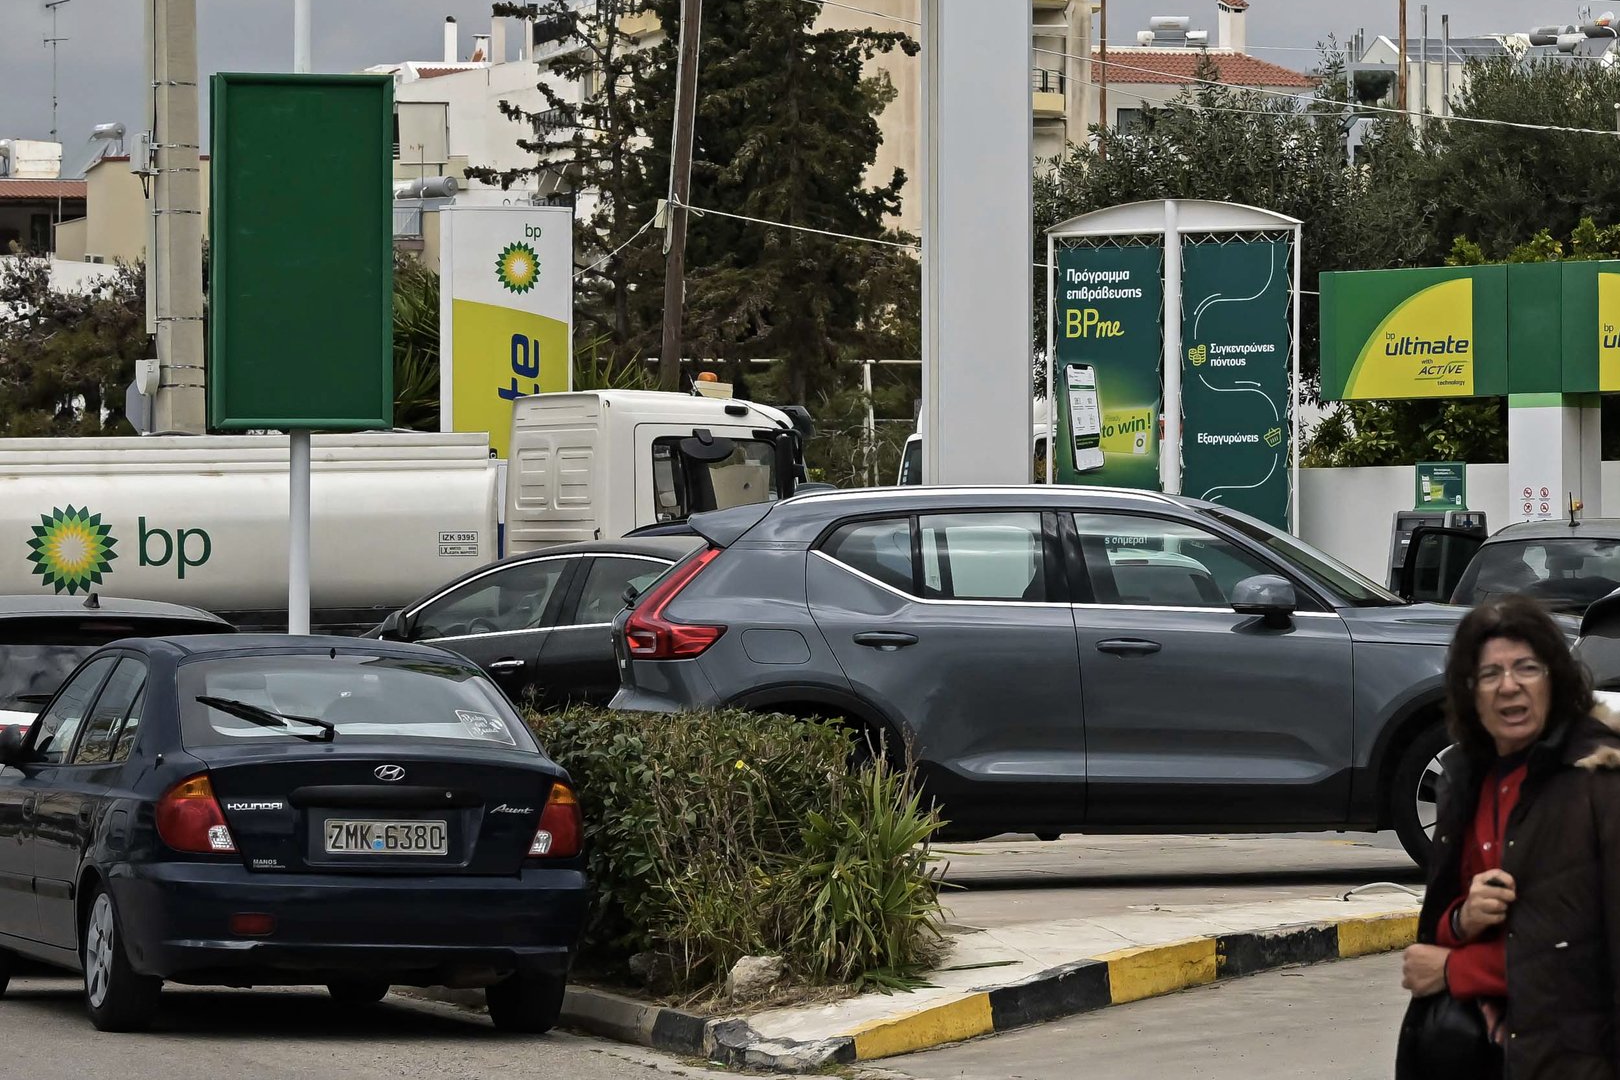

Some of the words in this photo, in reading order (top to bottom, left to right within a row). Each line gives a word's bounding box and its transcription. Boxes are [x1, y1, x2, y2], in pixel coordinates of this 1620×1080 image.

[525, 223, 542, 241] bp
[1066, 268, 1130, 284] Πρόγραμμα
[1066, 286, 1142, 302] επιβράβευσης
[1604, 323, 1614, 333] bp
[1386, 332, 1396, 341] bp
[1210, 342, 1275, 356] Συγκεντρώνεις
[1385, 335, 1469, 356] ultimate
[1210, 356, 1246, 367] πόντους
[1418, 364, 1464, 375] ACTIVE
[1102, 424, 1114, 438] to
[1197, 432, 1259, 445] Εξαργυρώνεις
[138, 517, 212, 579] bp
[227, 802, 283, 811] HYUNDAI
[490, 803, 534, 814] Accent
